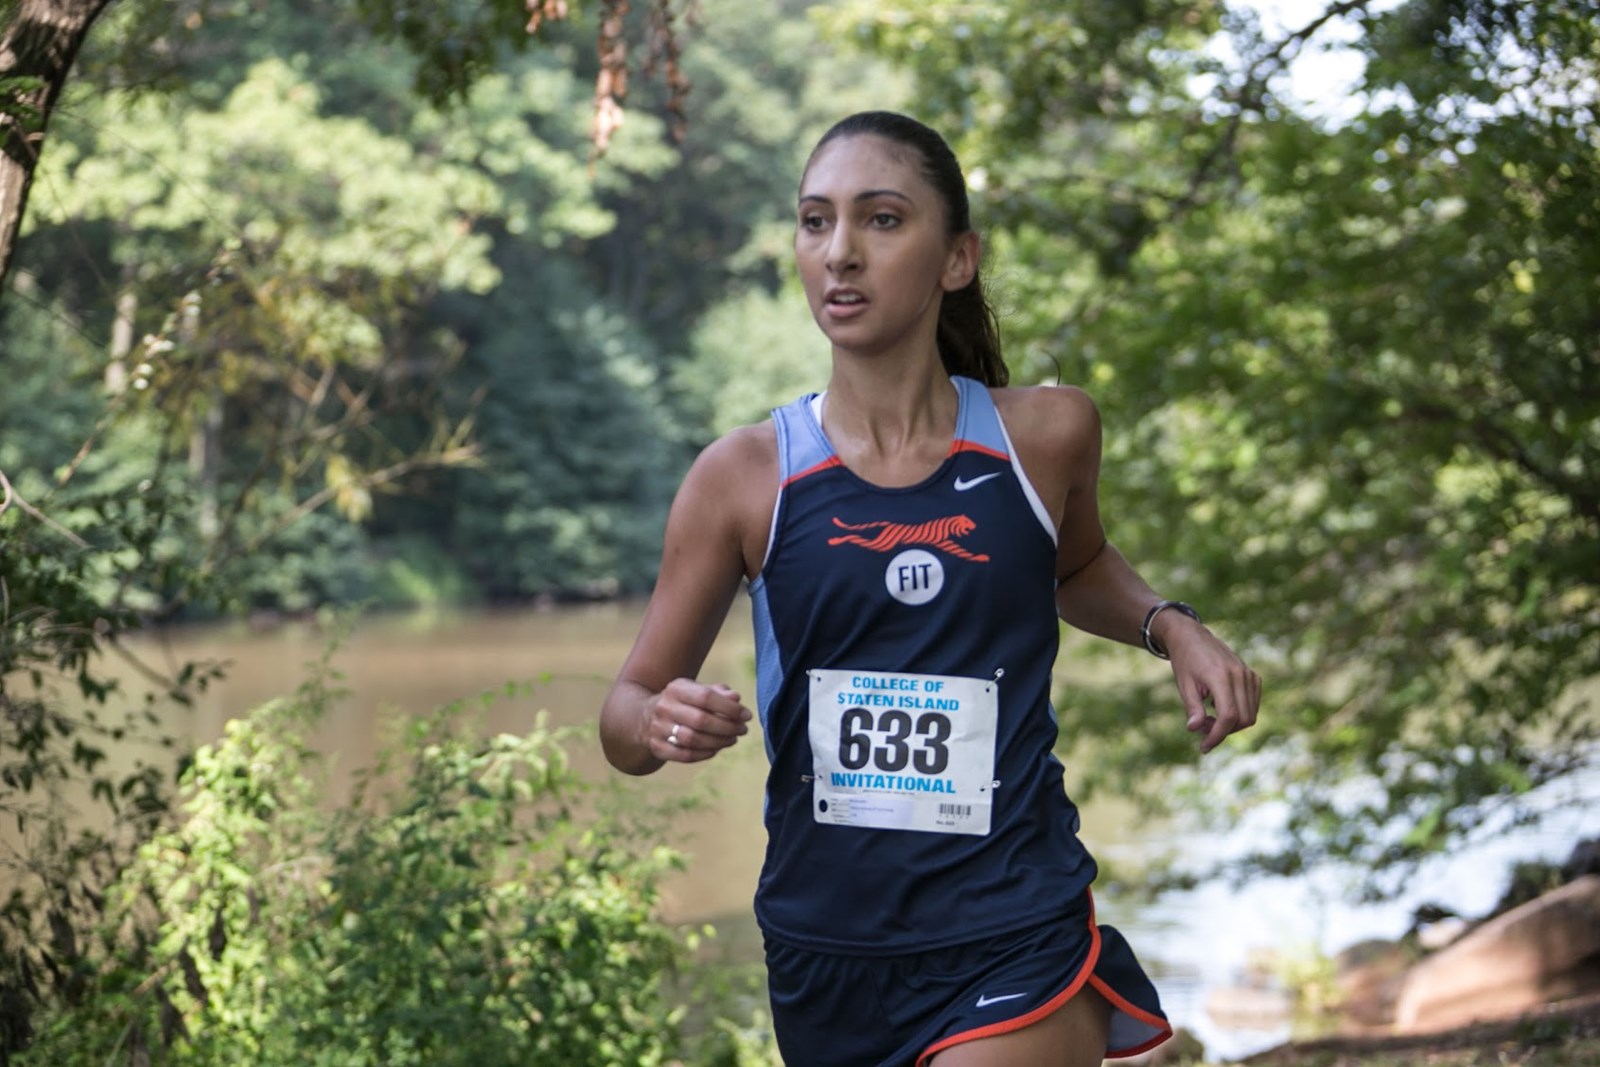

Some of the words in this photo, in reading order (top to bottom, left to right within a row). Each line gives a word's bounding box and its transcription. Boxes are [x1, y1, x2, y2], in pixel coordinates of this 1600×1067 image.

[898, 563, 932, 592] FIT
[852, 676, 918, 691] COLLEGE
[924, 680, 944, 693] OF
[837, 692, 895, 707] STATEN
[899, 696, 960, 711] ISLAND
[838, 707, 952, 775] 633
[830, 772, 957, 794] INVITATIONAL
